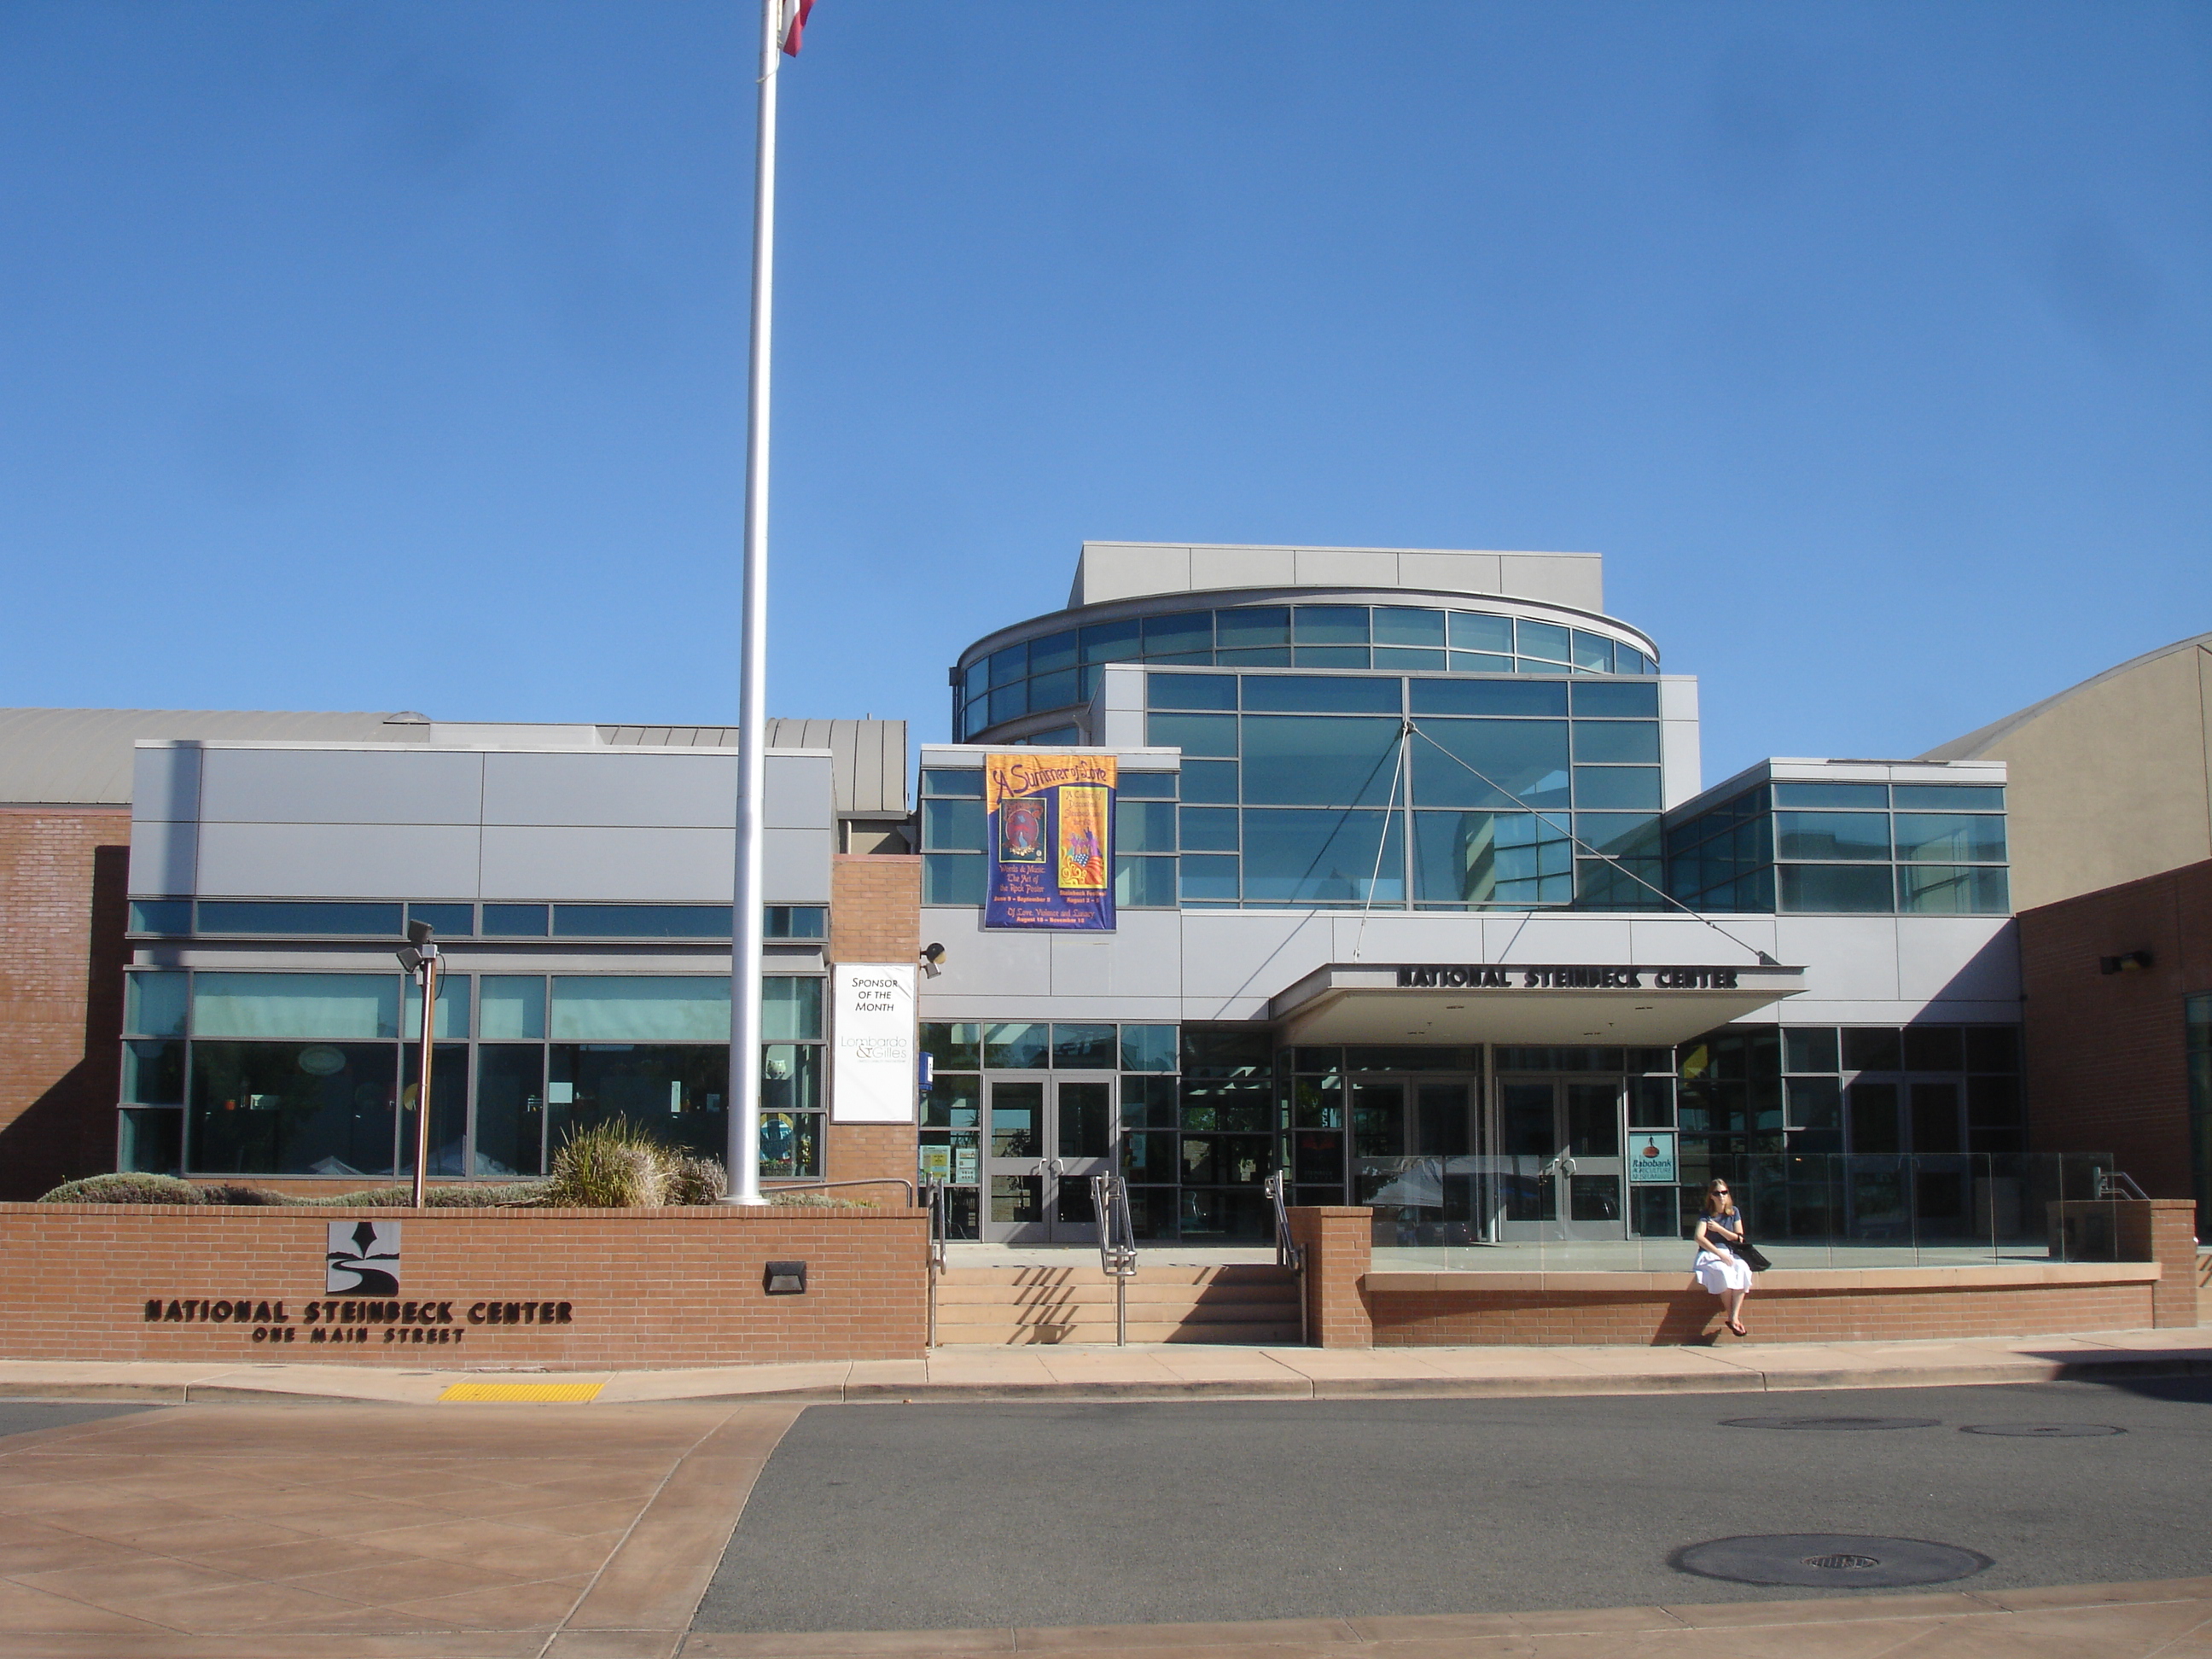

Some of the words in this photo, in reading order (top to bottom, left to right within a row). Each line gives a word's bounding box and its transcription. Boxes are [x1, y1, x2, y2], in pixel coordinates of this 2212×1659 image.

[992, 770, 1015, 805] A
[1011, 764, 1069, 794] Summer
[1071, 765, 1080, 781] of
[1080, 760, 1107, 782] Love
[999, 864, 1018, 873] Words
[1019, 864, 1026, 873] &
[1021, 874, 1032, 884] Art
[1033, 874, 1039, 885] of
[852, 977, 899, 987] SPONSOR
[1397, 966, 1512, 987] NATIONAL
[1523, 966, 1642, 988] STEINBECK
[1654, 967, 1738, 989] CENTER
[858, 991, 872, 999] OF
[874, 991, 892, 999] THE
[855, 1002, 894, 1011] MONTH
[841, 1035, 907, 1048] Lombardo
[1633, 1159, 1672, 1167] Rabobank
[144, 1300, 289, 1323] NATIONAL
[303, 1301, 454, 1324] STEINBECK
[467, 1301, 573, 1324] CENTER
[252, 1327, 295, 1343] ONE
[310, 1327, 368, 1343] MAIN
[383, 1328, 465, 1344] STREET
